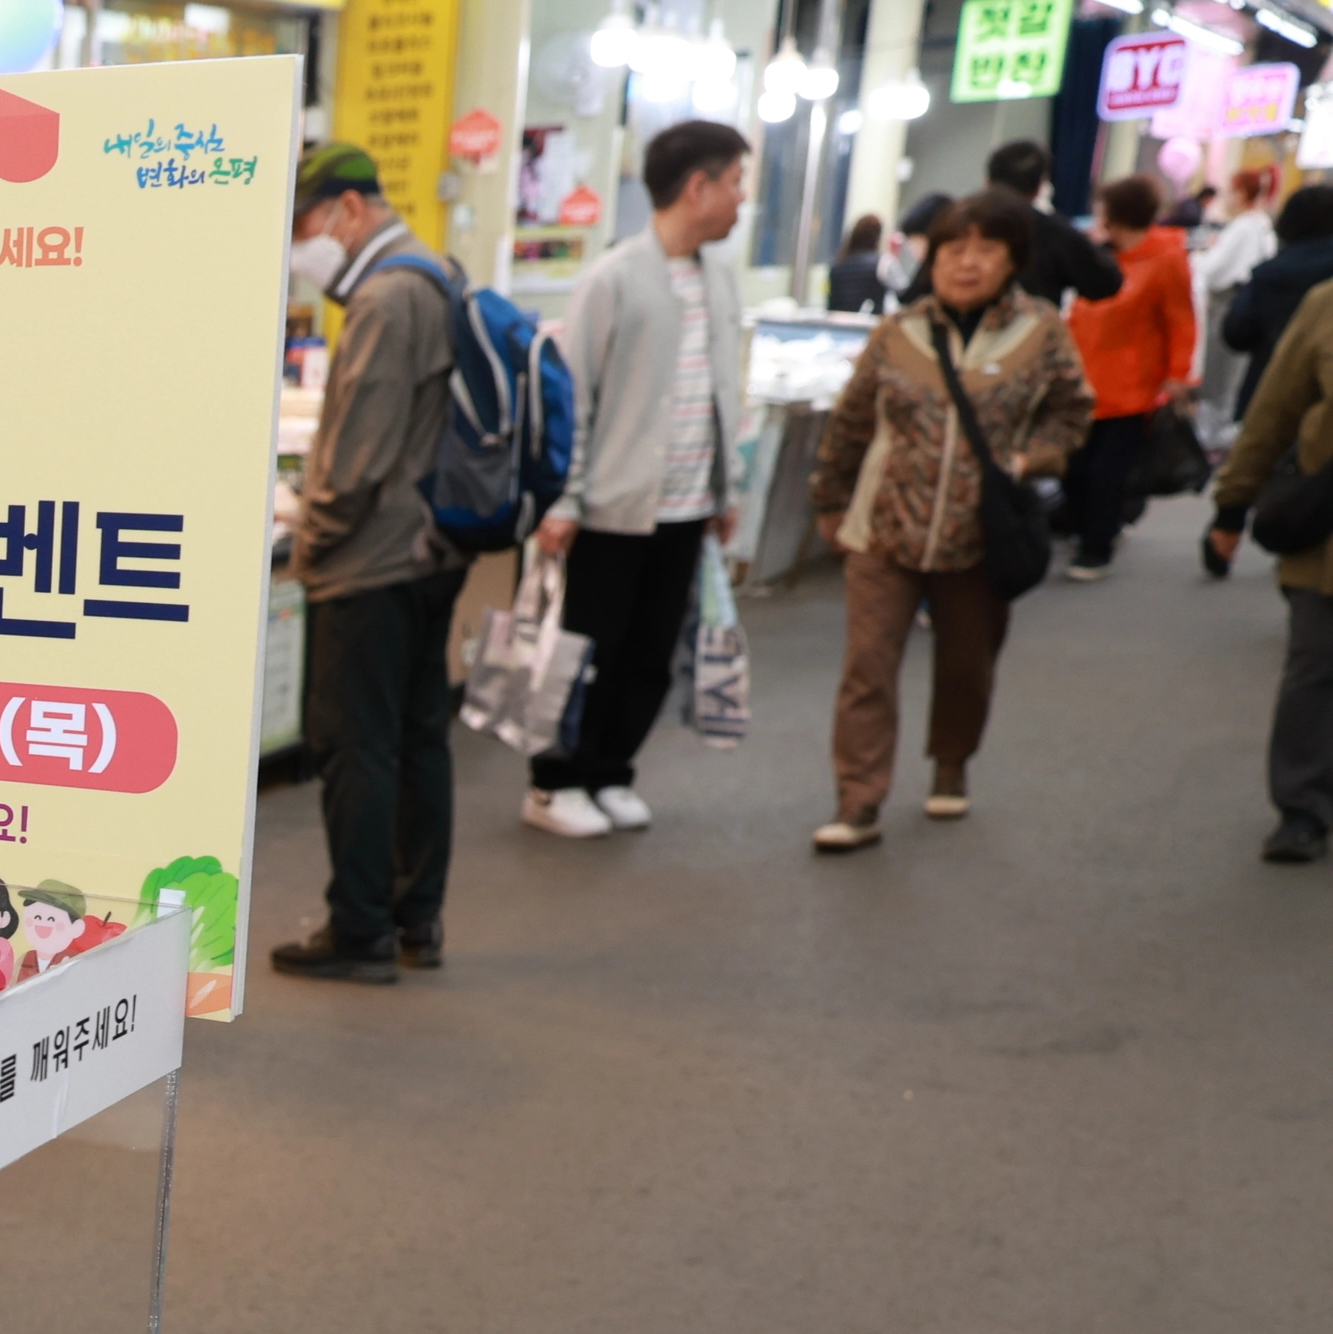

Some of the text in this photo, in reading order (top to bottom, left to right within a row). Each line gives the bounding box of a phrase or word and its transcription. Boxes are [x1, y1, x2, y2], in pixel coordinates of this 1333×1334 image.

[1107, 44, 1185, 91] BYC
[104, 118, 225, 161] 내일의 중심
[136, 158, 206, 189] 변화의
[30, 994, 137, 1083] 깨워주세요!
